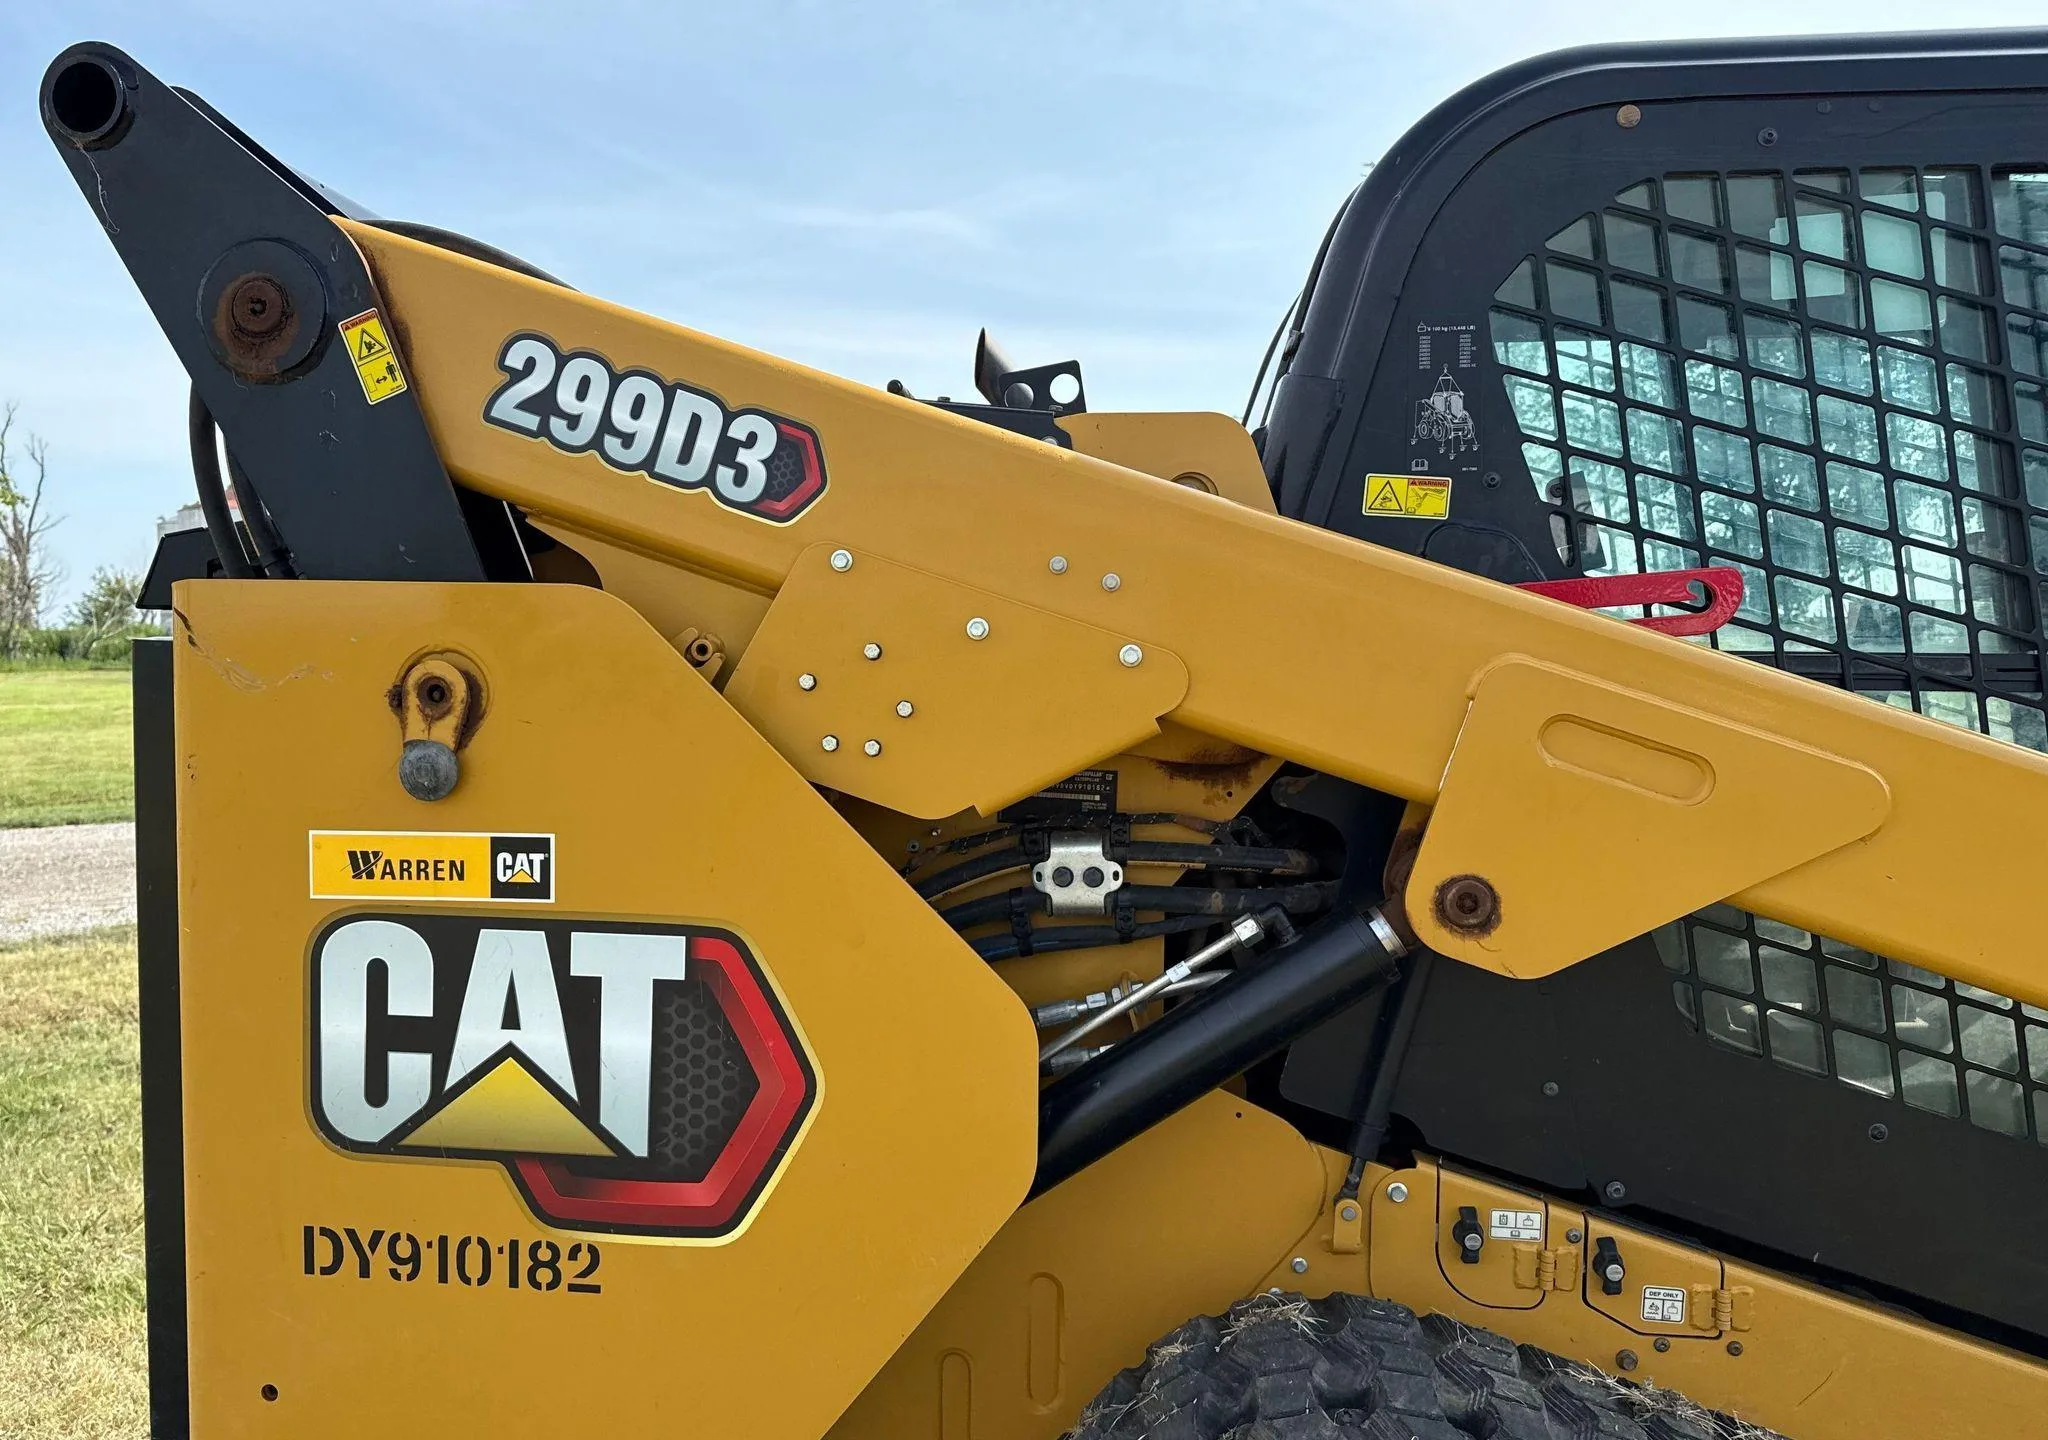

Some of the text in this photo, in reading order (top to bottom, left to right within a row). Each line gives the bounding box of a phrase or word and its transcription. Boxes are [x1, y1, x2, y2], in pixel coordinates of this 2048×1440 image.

[350, 313, 376, 327] WARNING
[490, 340, 777, 502] 299D3
[347, 850, 545, 884] WARREN CAT
[320, 920, 686, 1158] CAT
[303, 1225, 601, 1293] DY910182
